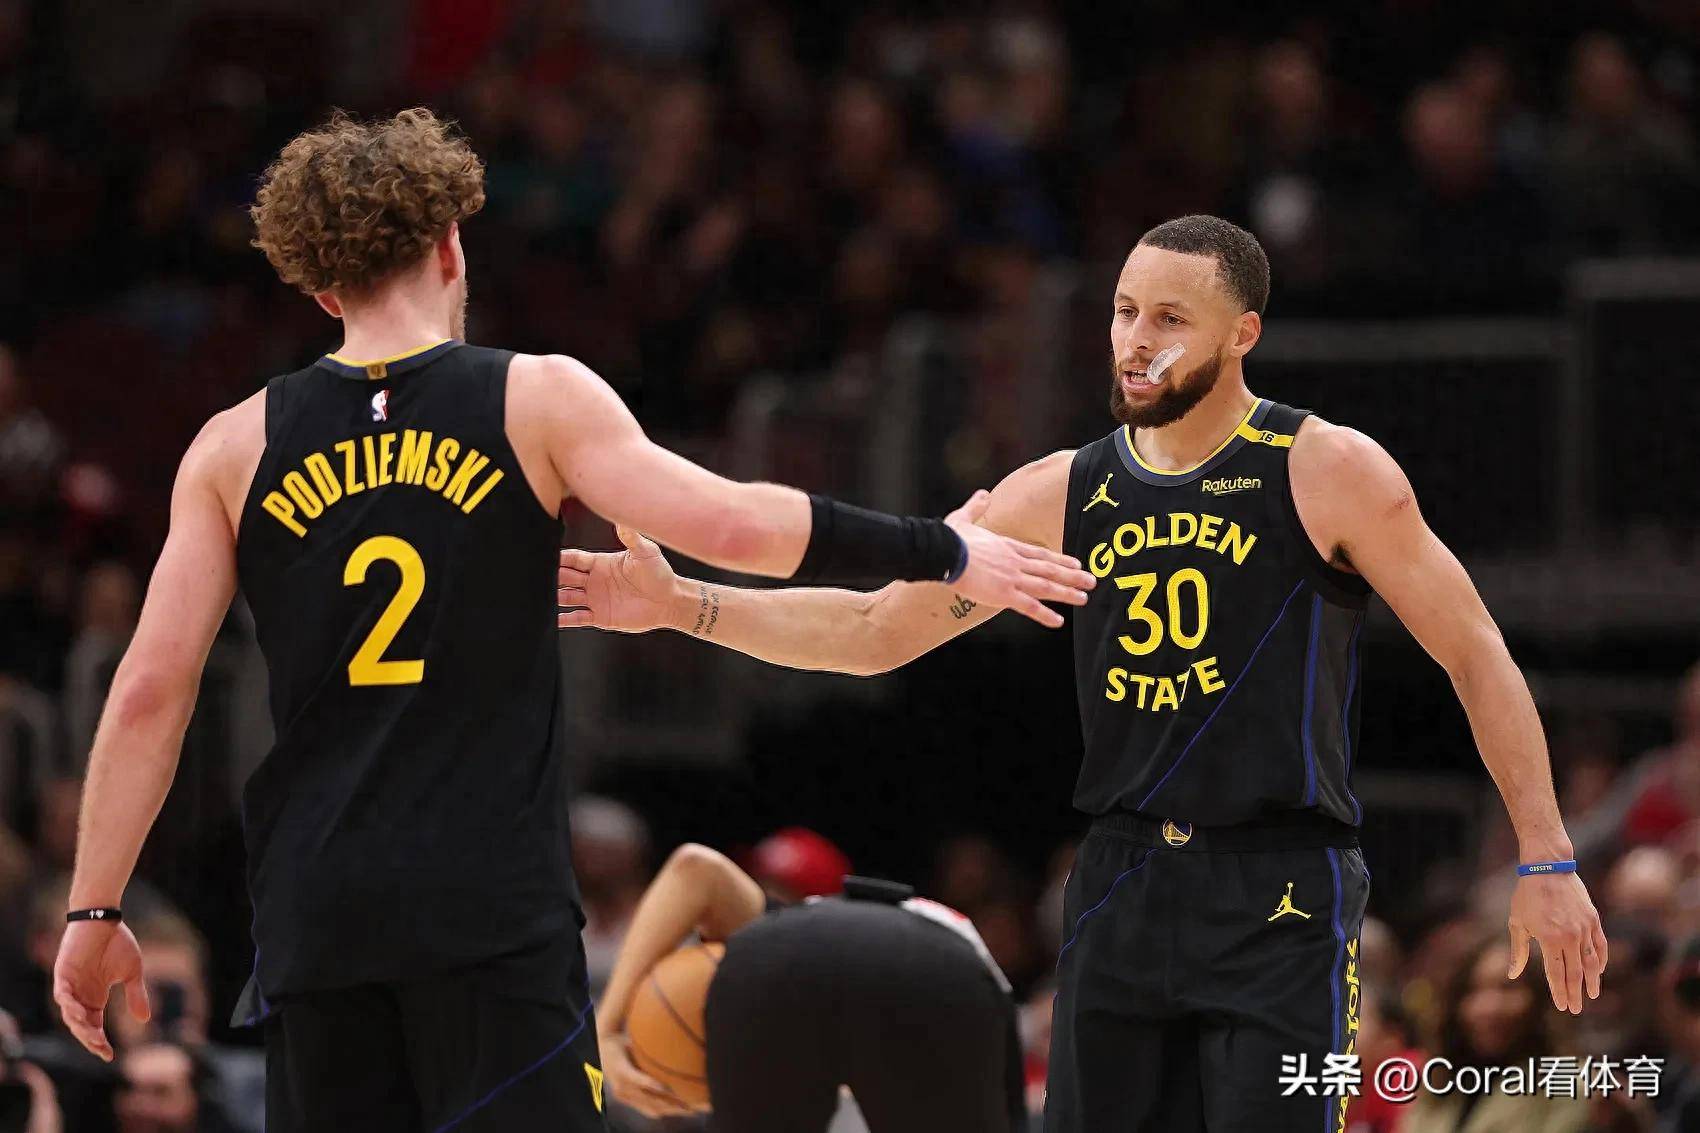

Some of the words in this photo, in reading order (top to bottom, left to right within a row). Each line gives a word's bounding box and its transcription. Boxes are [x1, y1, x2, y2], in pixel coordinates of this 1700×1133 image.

[1259, 431, 1275, 443] 16
[261, 429, 505, 538] PODZIEMSKI
[1201, 476, 1263, 494] Rakuten
[1089, 512, 1257, 578] GOLDEN
[343, 535, 426, 686] 2
[1114, 568, 1209, 656] 30
